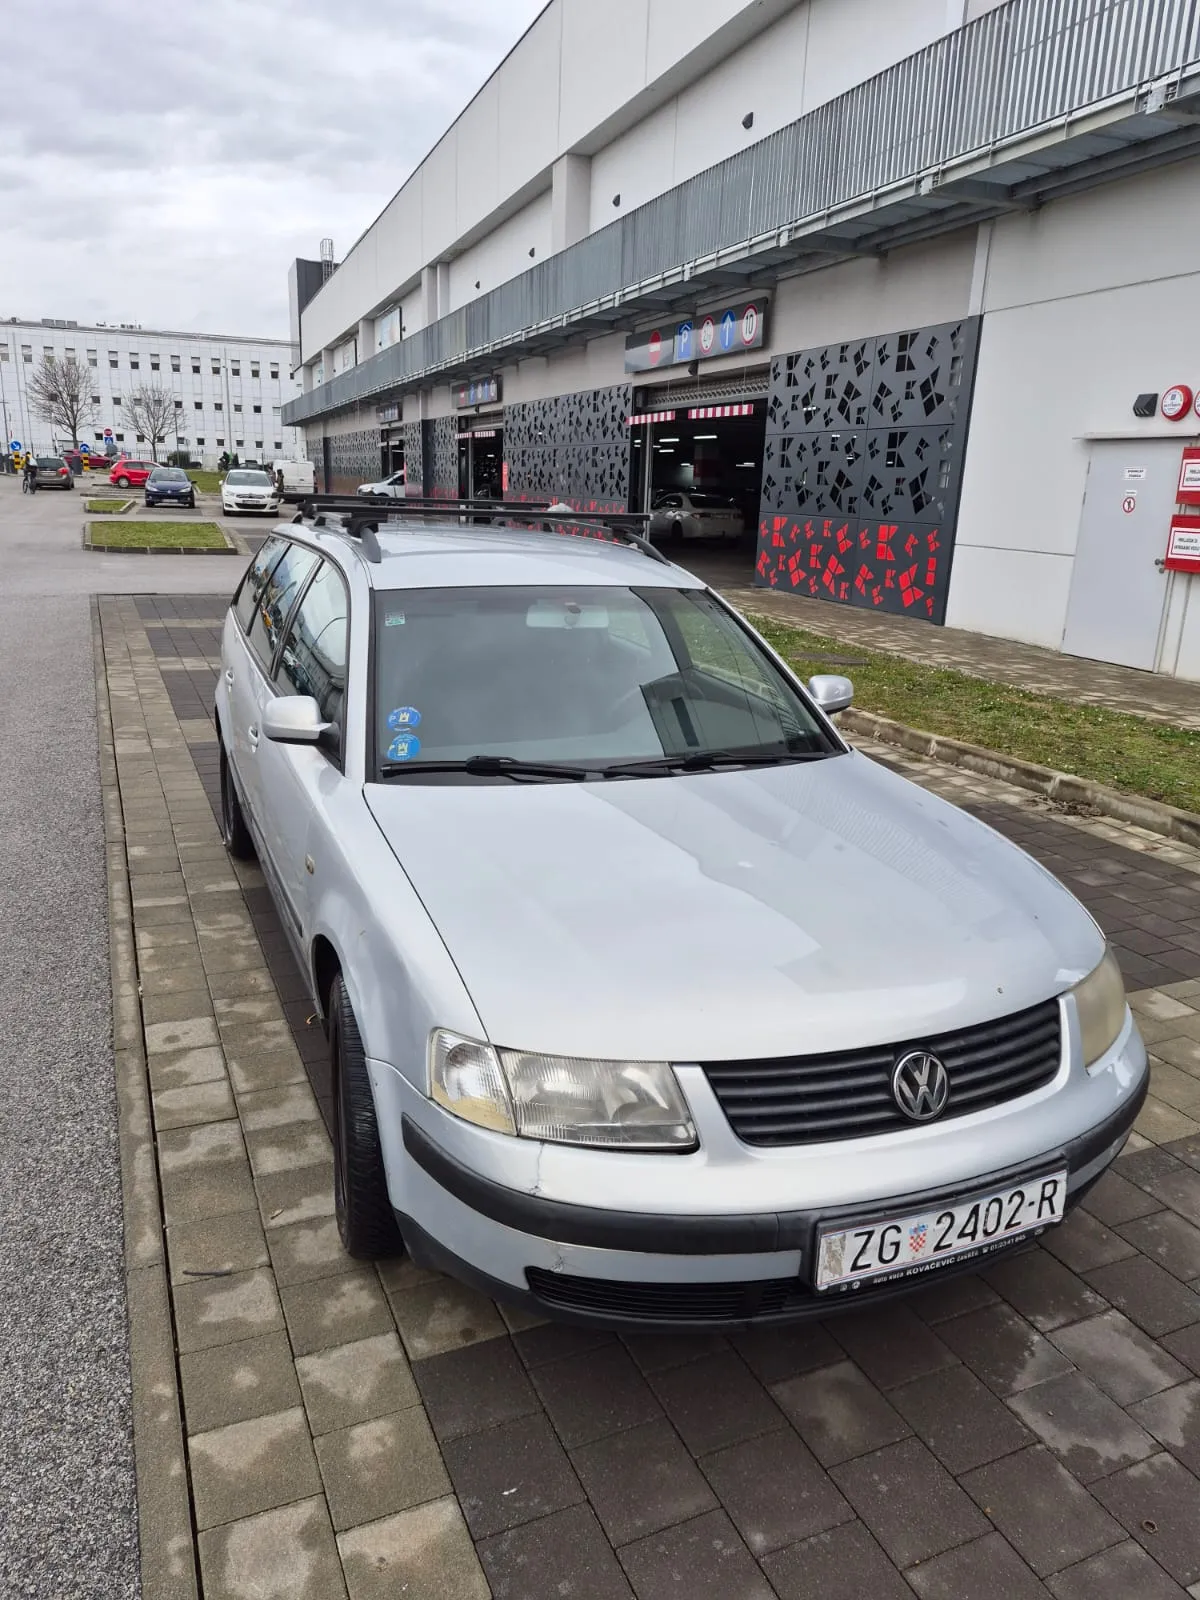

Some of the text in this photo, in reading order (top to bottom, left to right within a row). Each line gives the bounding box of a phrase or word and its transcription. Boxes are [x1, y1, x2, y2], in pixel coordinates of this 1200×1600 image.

[744, 313, 754, 335] 10
[850, 1179, 1058, 1273] ZG 2402-R
